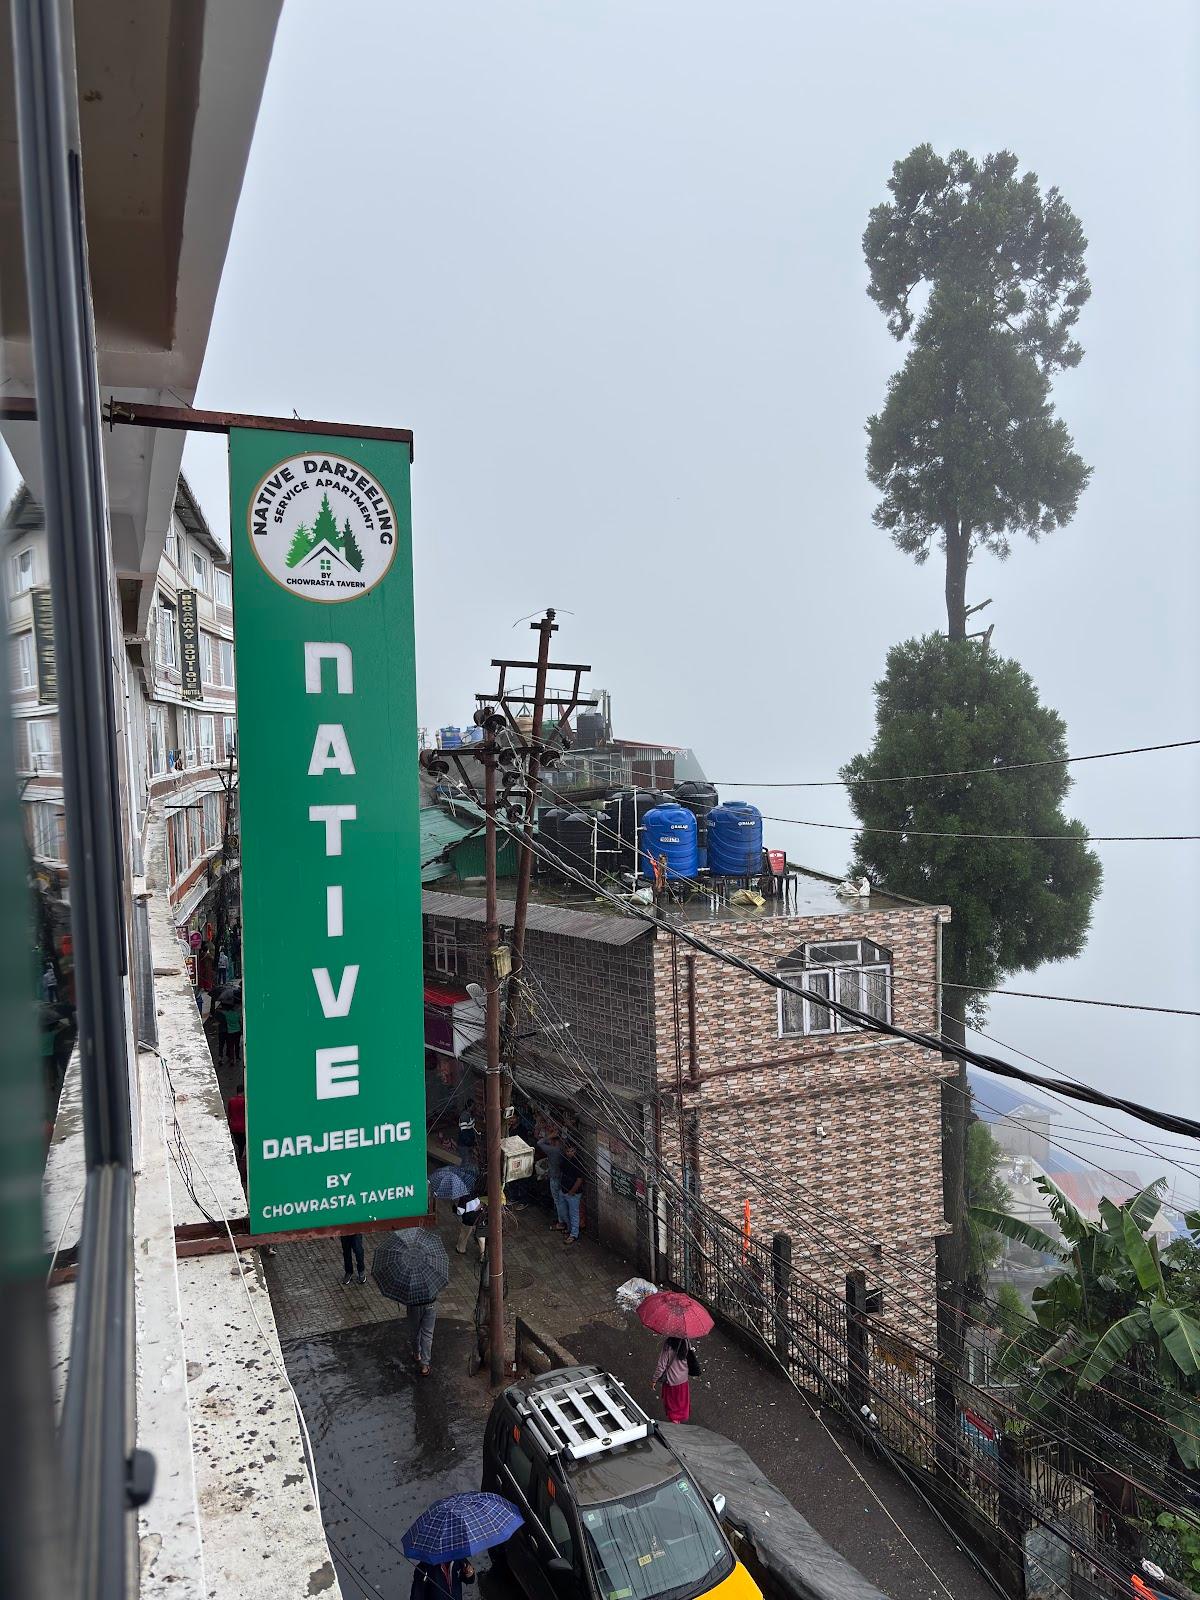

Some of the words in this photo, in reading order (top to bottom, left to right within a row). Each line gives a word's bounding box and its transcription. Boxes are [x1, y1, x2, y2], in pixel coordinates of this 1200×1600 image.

[253, 467, 295, 536] NATIVE
[303, 460, 393, 545] DARJEELING
[274, 480, 310, 524] SERVICE
[315, 478, 374, 531] APARTMENT
[286, 578, 335, 587] CHOWRASTA
[336, 580, 366, 588] TAVERN
[181, 594, 195, 640] BROADWAY
[184, 643, 197, 689] BOUTIQUE
[304, 641, 360, 1101] NATIVE
[262, 1121, 411, 1160] DARJEELING
[262, 1193, 357, 1219] CHOWRASTA
[360, 1184, 415, 1204] TAVERN
[326, 1172, 352, 1189] BY
